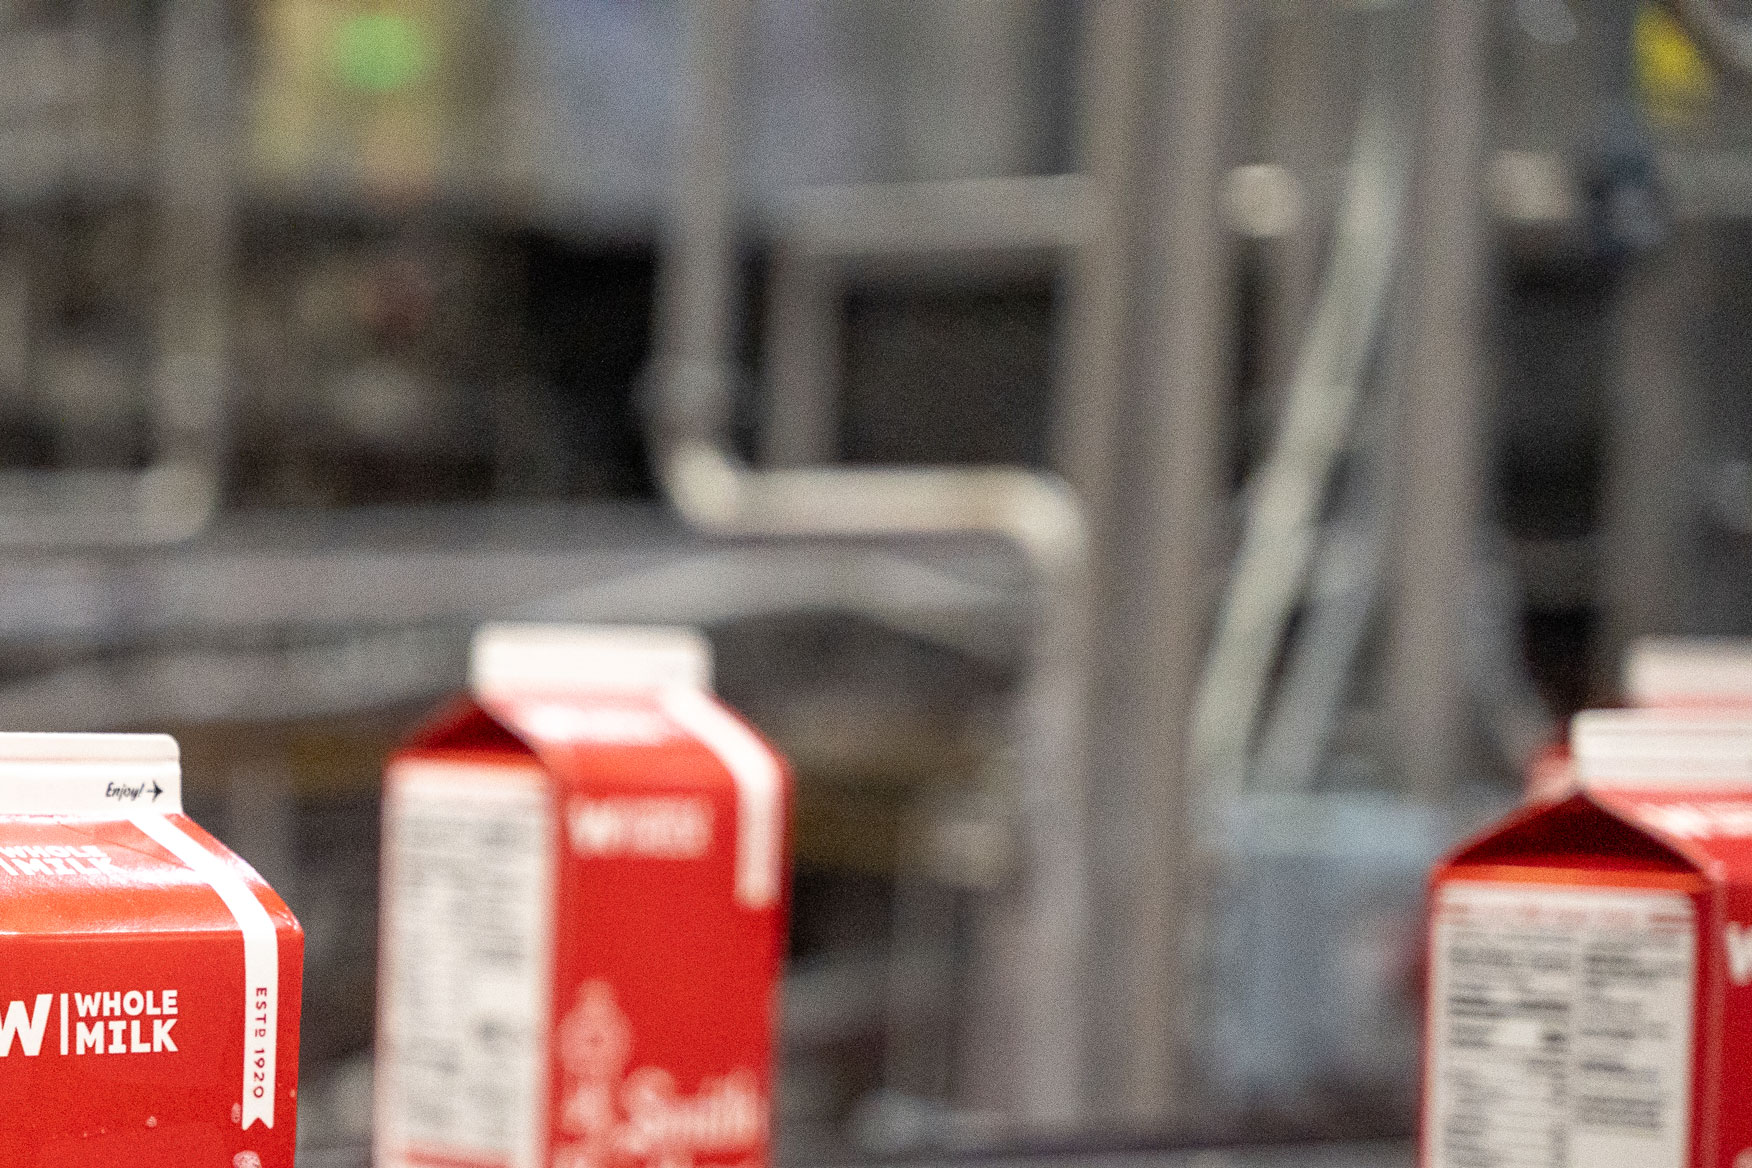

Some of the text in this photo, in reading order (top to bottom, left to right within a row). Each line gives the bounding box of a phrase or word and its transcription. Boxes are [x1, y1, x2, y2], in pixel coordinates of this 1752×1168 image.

[105, 781, 145, 802] Enjoy!
[11, 857, 113, 876] MILK
[74, 990, 178, 1017] WHOLE
[76, 1018, 178, 1055] MILK
[253, 1048, 265, 1098] 1920
